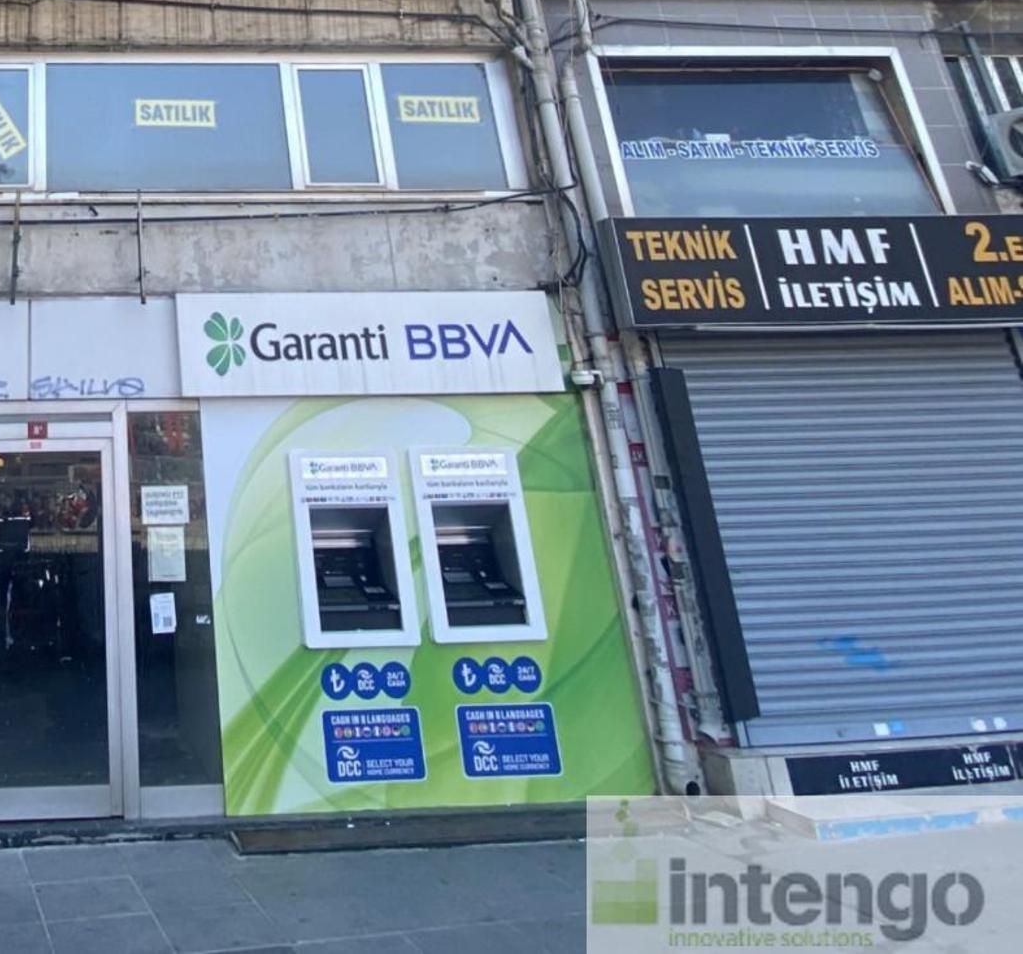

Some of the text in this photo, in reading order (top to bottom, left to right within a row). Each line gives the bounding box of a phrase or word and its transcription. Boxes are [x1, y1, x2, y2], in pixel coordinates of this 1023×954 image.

[139, 103, 212, 123] SATILIK
[403, 99, 478, 120] SATILIK
[621, 140, 667, 159] ALIM
[677, 140, 735, 159] SATIM
[742, 138, 811, 159] TEKNİK
[814, 134, 880, 159] SERVİS
[626, 224, 738, 261] TEKNİK
[777, 228, 891, 265] HMF
[641, 271, 746, 310] SERVİS
[778, 277, 921, 313] İLETİŞİM
[249, 319, 535, 361] Garanti BBVA
[337, 760, 362, 777] DCC
[473, 755, 498, 772] DCC
[850, 760, 880, 773] HMF
[963, 752, 992, 765] HMF
